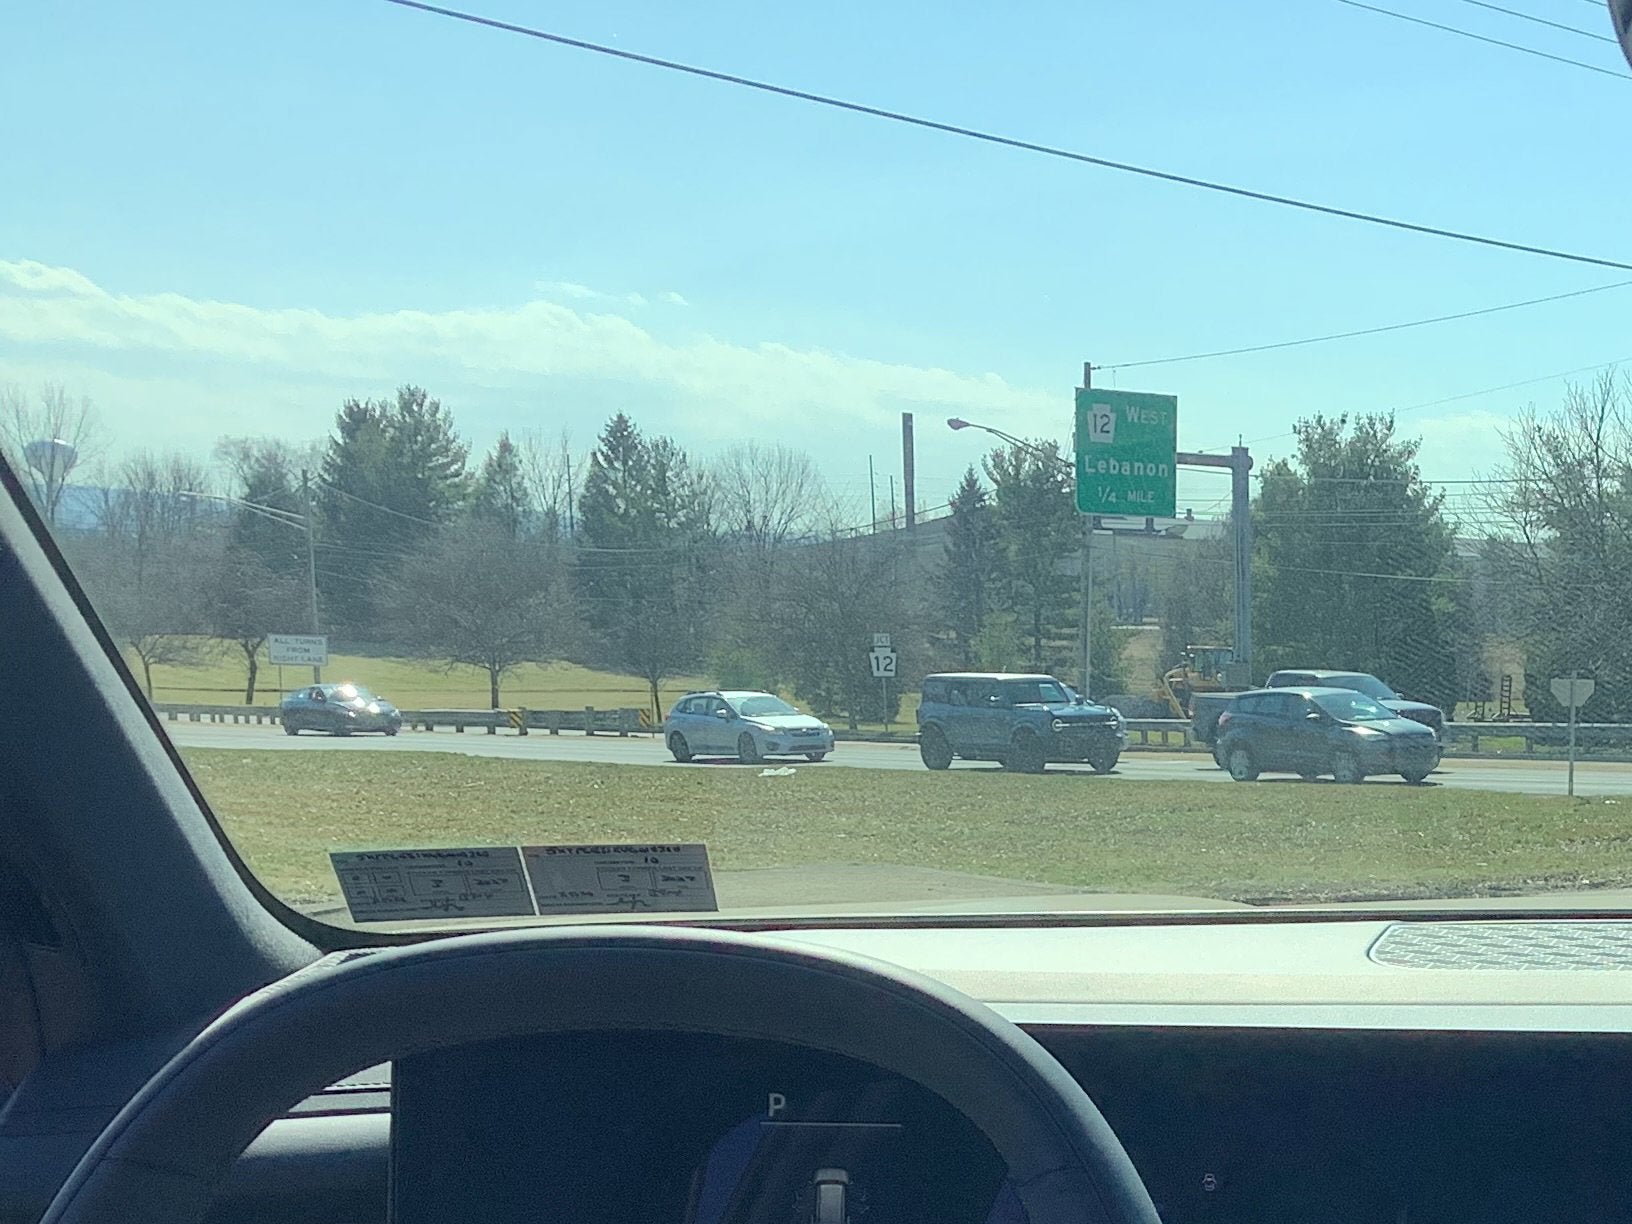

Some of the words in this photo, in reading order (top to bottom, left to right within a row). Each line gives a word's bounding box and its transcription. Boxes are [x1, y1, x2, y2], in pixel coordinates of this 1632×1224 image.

[1093, 413, 1111, 434] 12
[1125, 405, 1168, 425] WEST
[1084, 454, 1169, 477] Lebanon
[1127, 490, 1155, 503] MILE
[875, 634, 889, 645] JCT
[874, 655, 894, 672] 12
[768, 1092, 786, 1117] P
